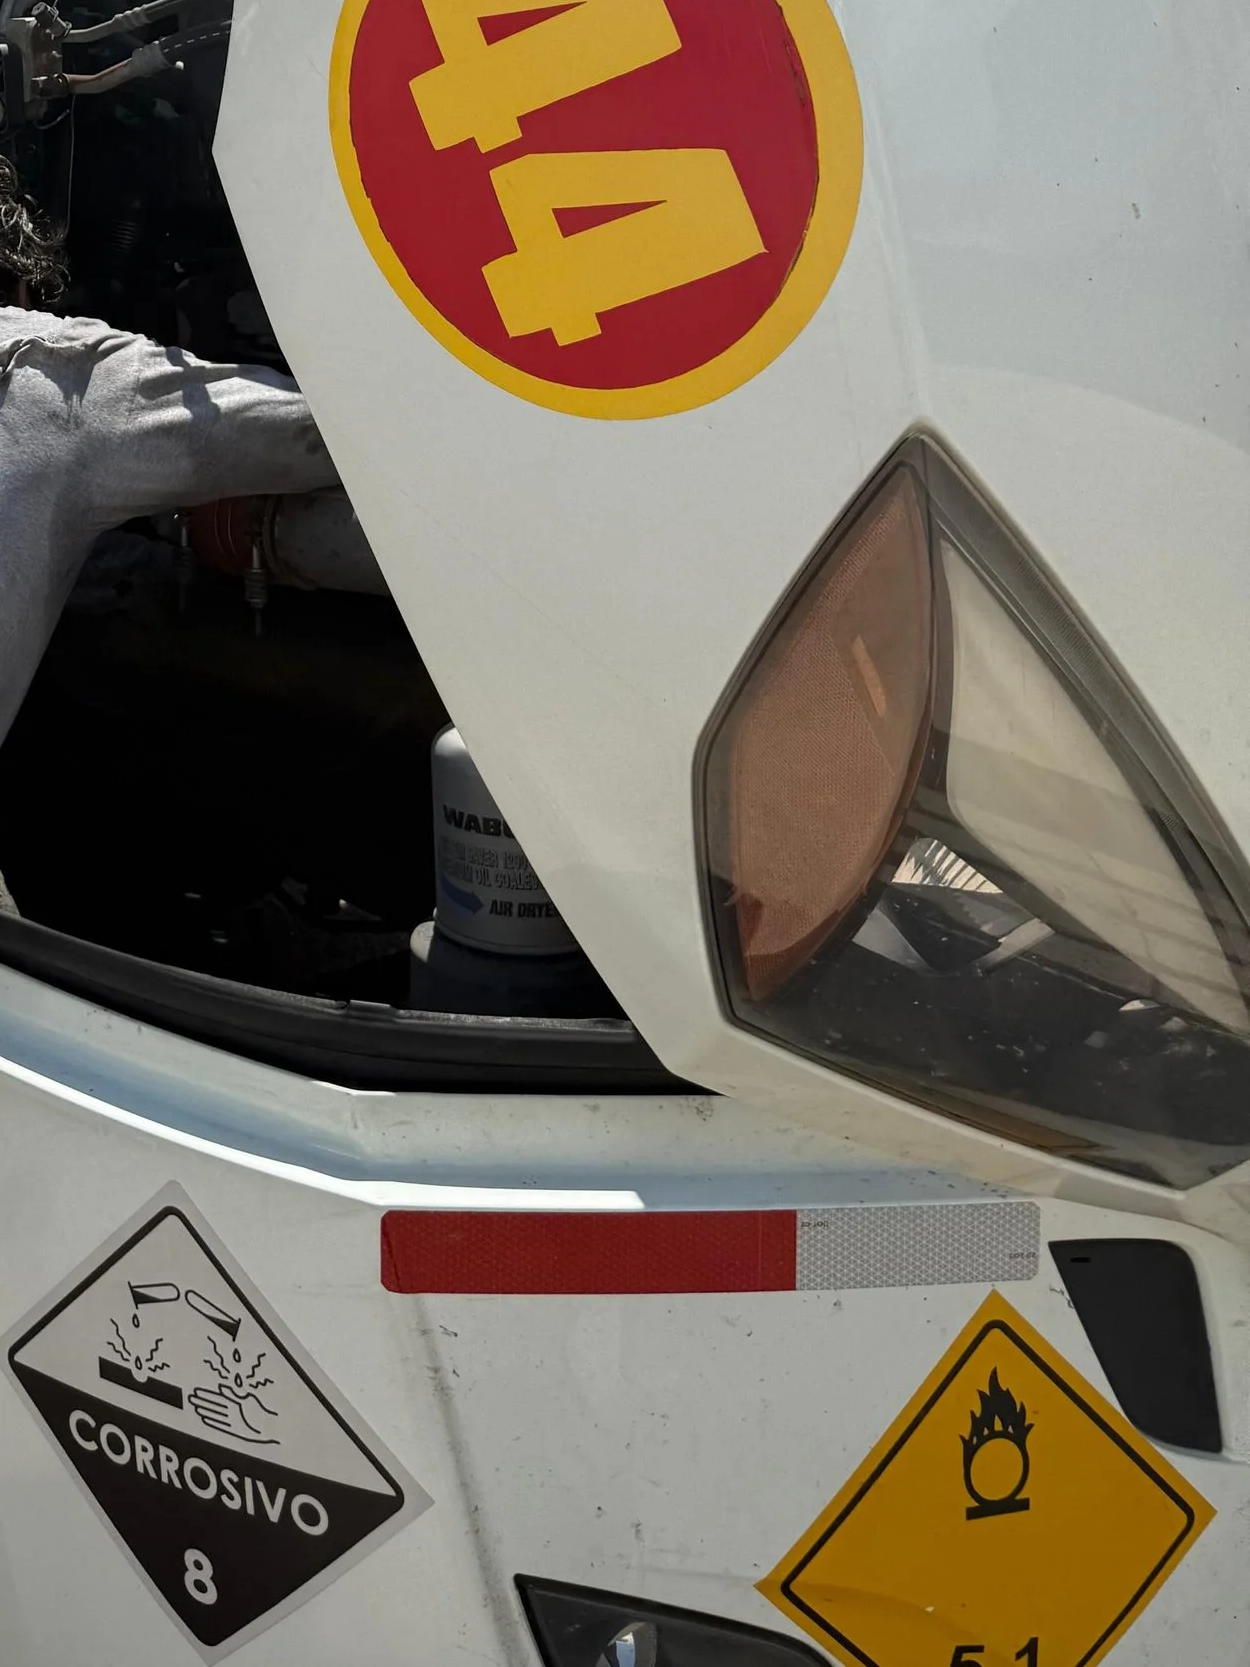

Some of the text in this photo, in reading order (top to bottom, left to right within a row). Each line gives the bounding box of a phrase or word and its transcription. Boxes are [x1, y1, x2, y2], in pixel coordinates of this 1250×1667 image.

[489, 899, 513, 917] AIR
[67, 1409, 330, 1537] CORROSIVO
[182, 1547, 219, 1606] 8
